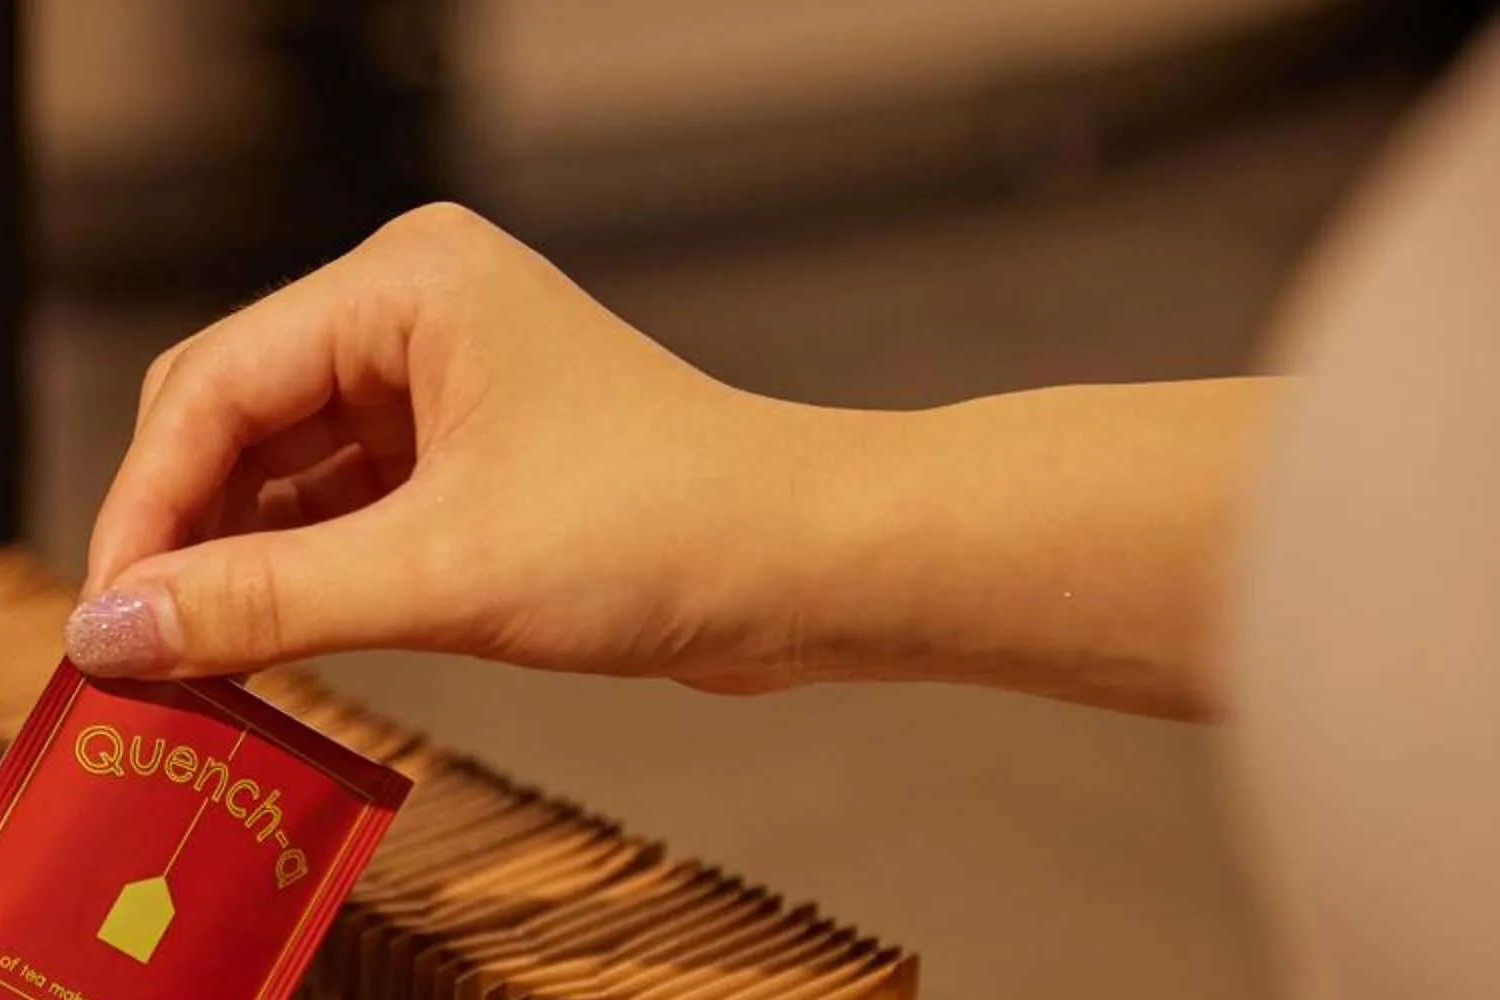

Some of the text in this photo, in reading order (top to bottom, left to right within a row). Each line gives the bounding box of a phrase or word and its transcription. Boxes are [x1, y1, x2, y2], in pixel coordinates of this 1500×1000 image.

[75, 724, 309, 890] Quench-a
[0, 954, 21, 973] of
[20, 963, 47, 988] tea
